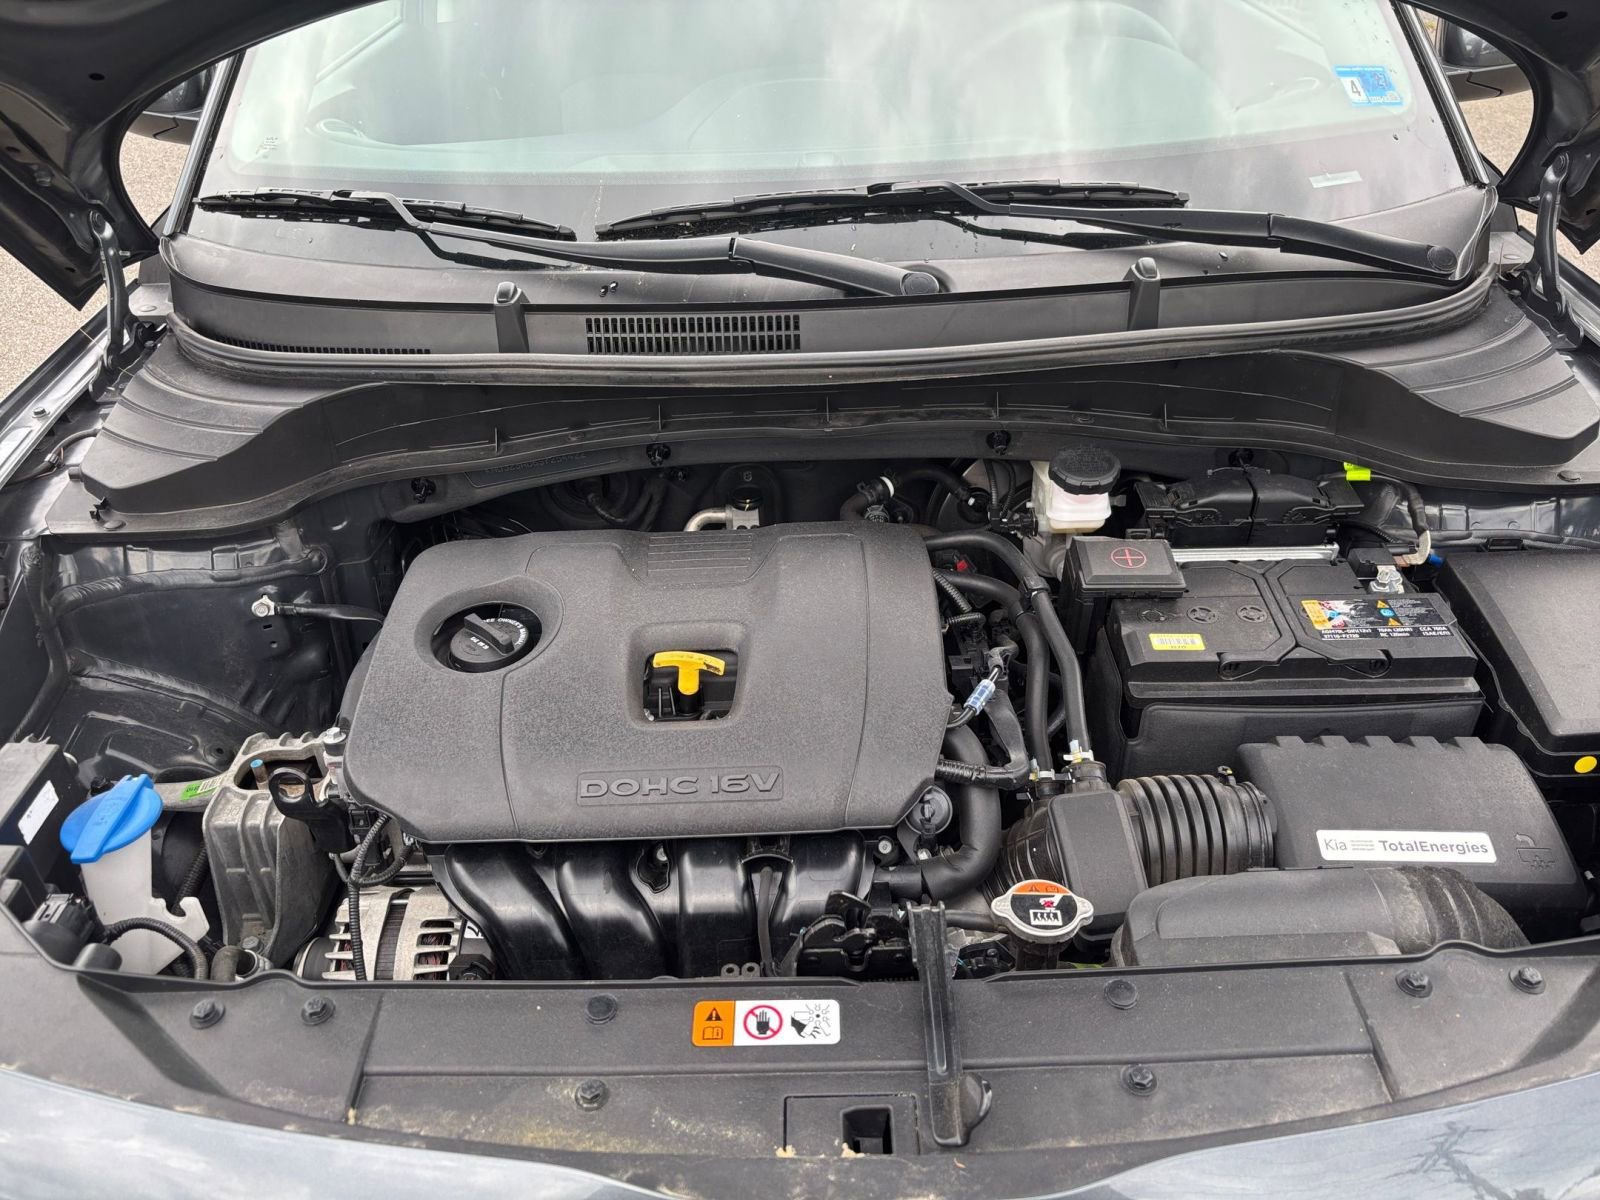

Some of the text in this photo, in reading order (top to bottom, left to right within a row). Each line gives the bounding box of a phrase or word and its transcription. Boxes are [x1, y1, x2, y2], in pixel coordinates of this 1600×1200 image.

[1350, 79, 1362, 97] 4
[580, 772, 780, 798] DOHC 16V
[1323, 838, 1348, 851] Kia
[1378, 839, 1489, 855] TotalEnergies
